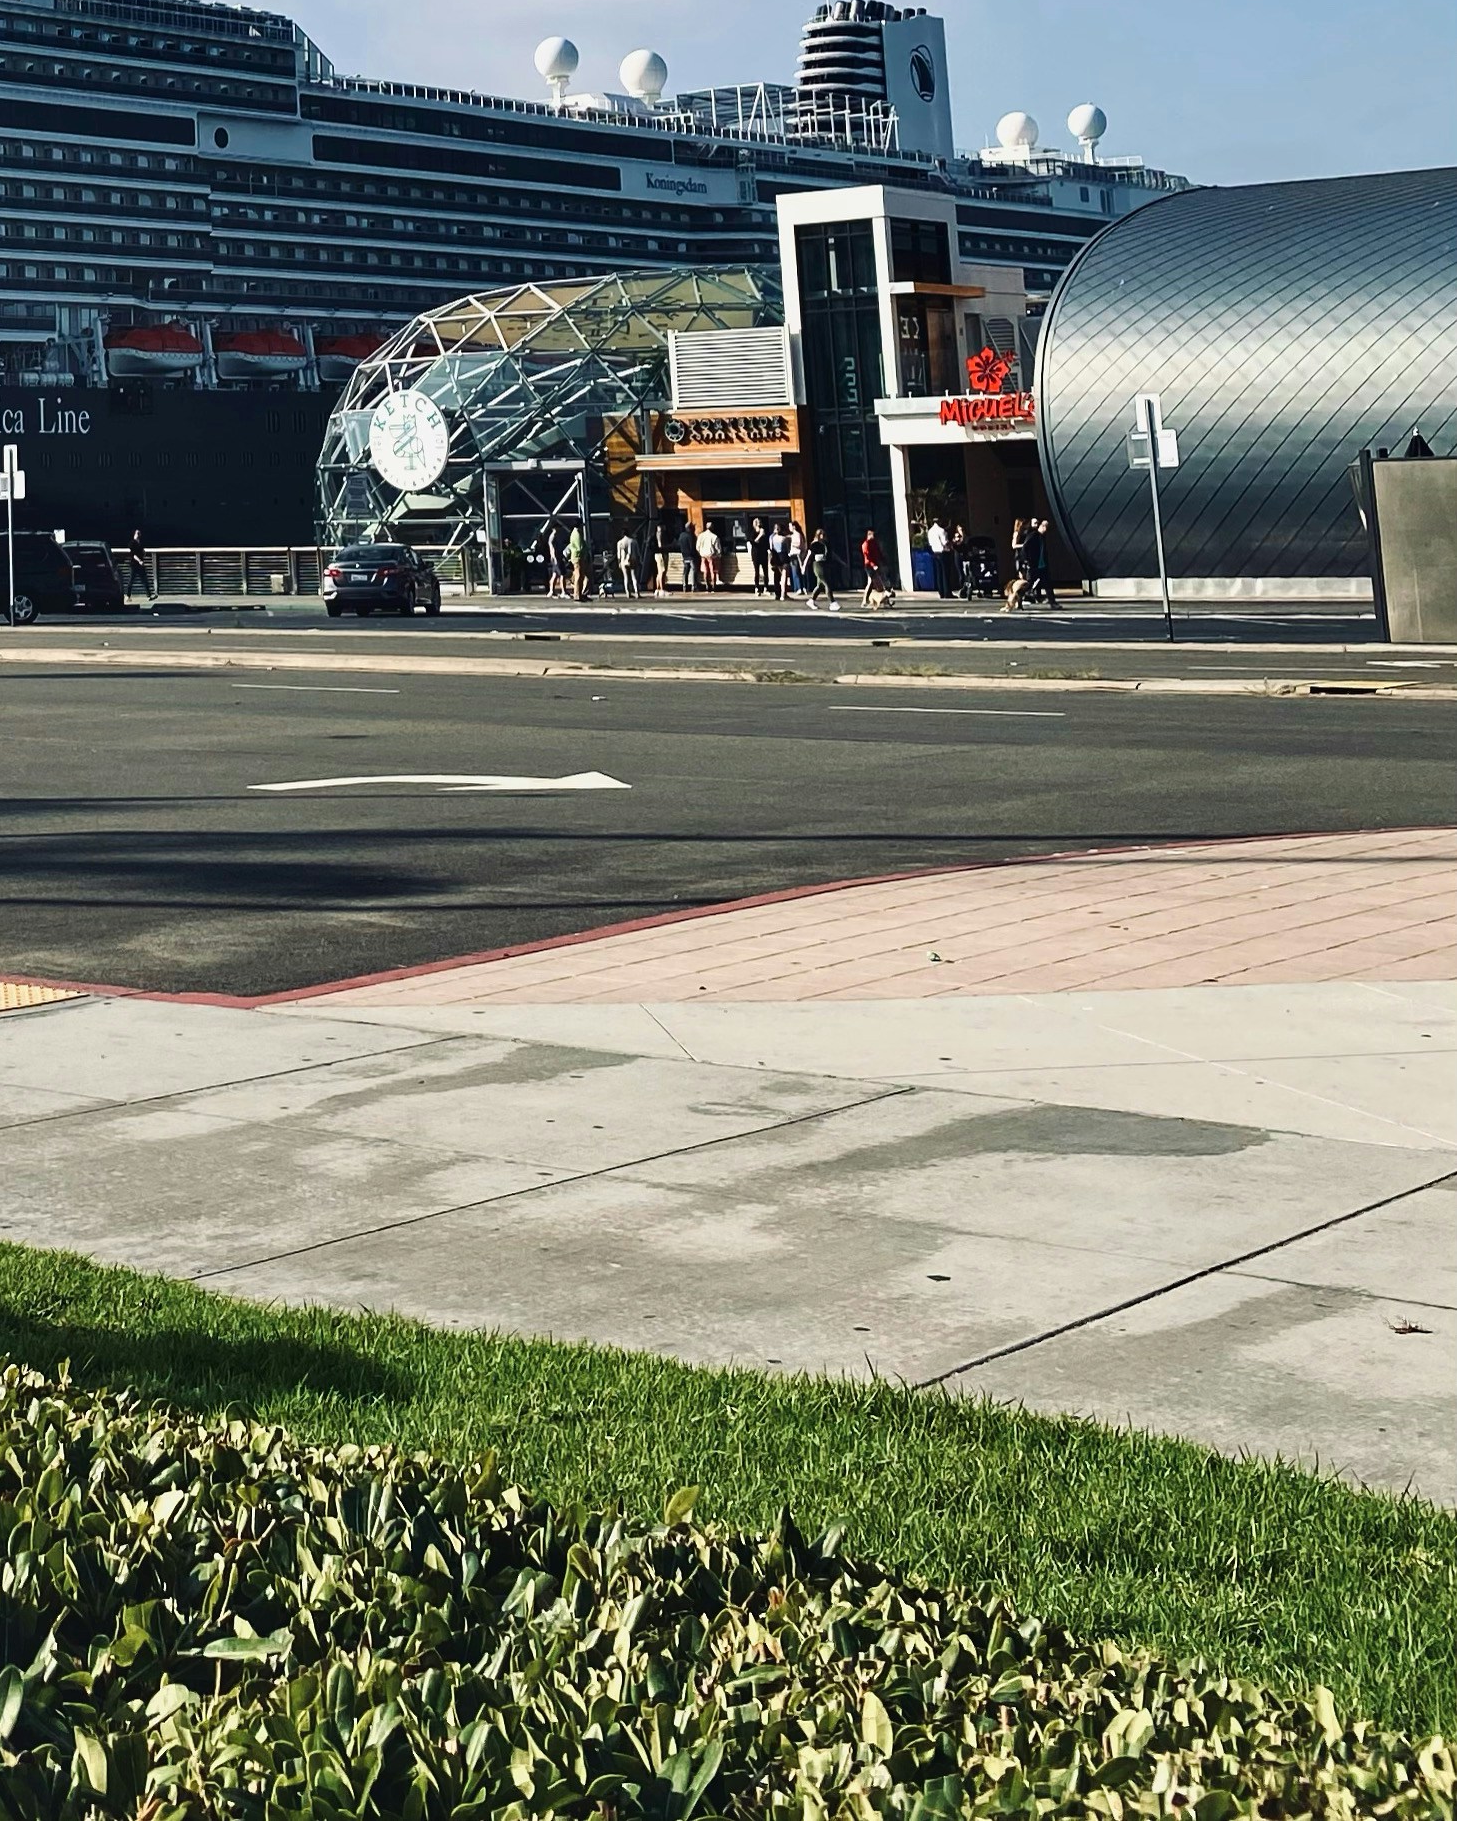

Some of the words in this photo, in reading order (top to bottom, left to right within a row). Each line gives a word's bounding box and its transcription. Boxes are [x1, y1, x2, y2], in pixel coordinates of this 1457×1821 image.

[646, 172, 707, 196] Koningsdam
[38, 397, 90, 434] Line
[373, 394, 442, 431] KETCH
